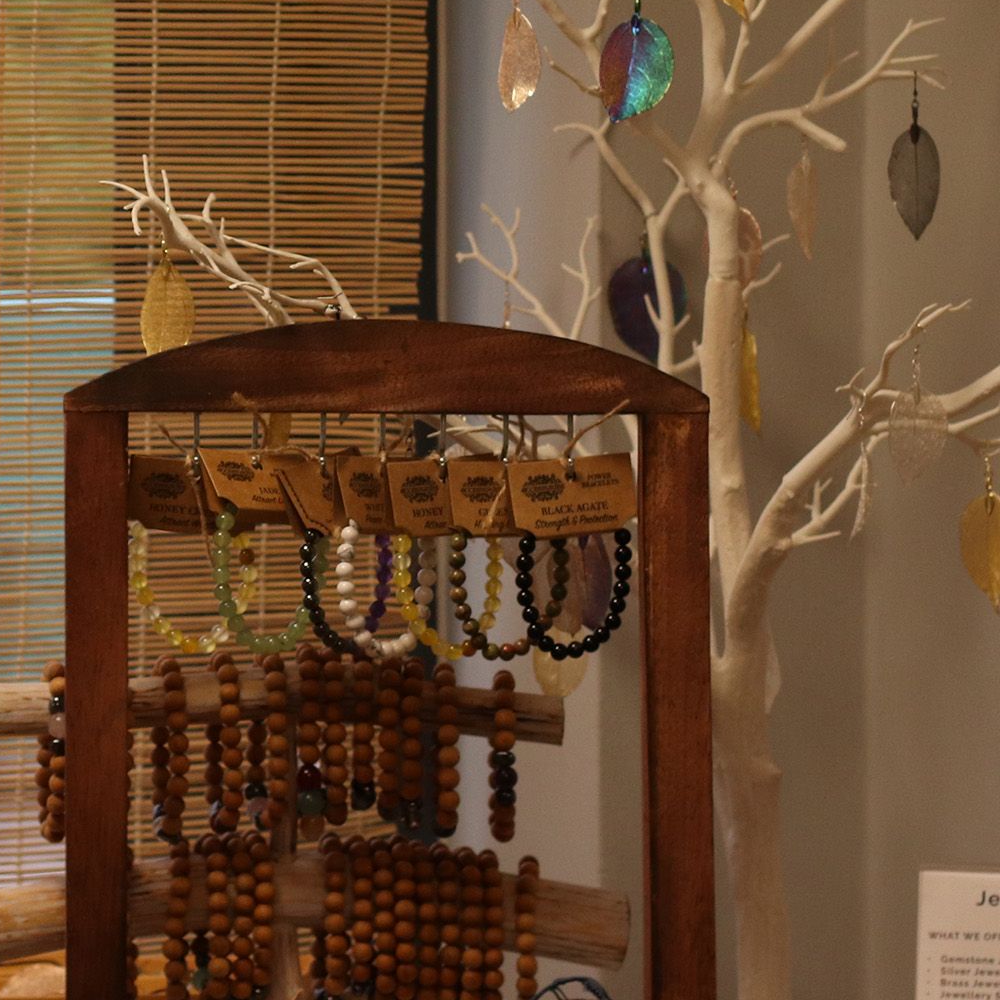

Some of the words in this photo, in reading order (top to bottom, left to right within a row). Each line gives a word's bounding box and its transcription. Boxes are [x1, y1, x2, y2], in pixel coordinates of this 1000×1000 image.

[412, 506, 444, 518] HONEY
[541, 503, 574, 516] BLACK
[577, 501, 609, 512] AGATE
[976, 890, 1000, 907] Je
[928, 931, 960, 940] WHAT
[963, 932, 980, 941] WE
[940, 955, 995, 965] Gemstone
